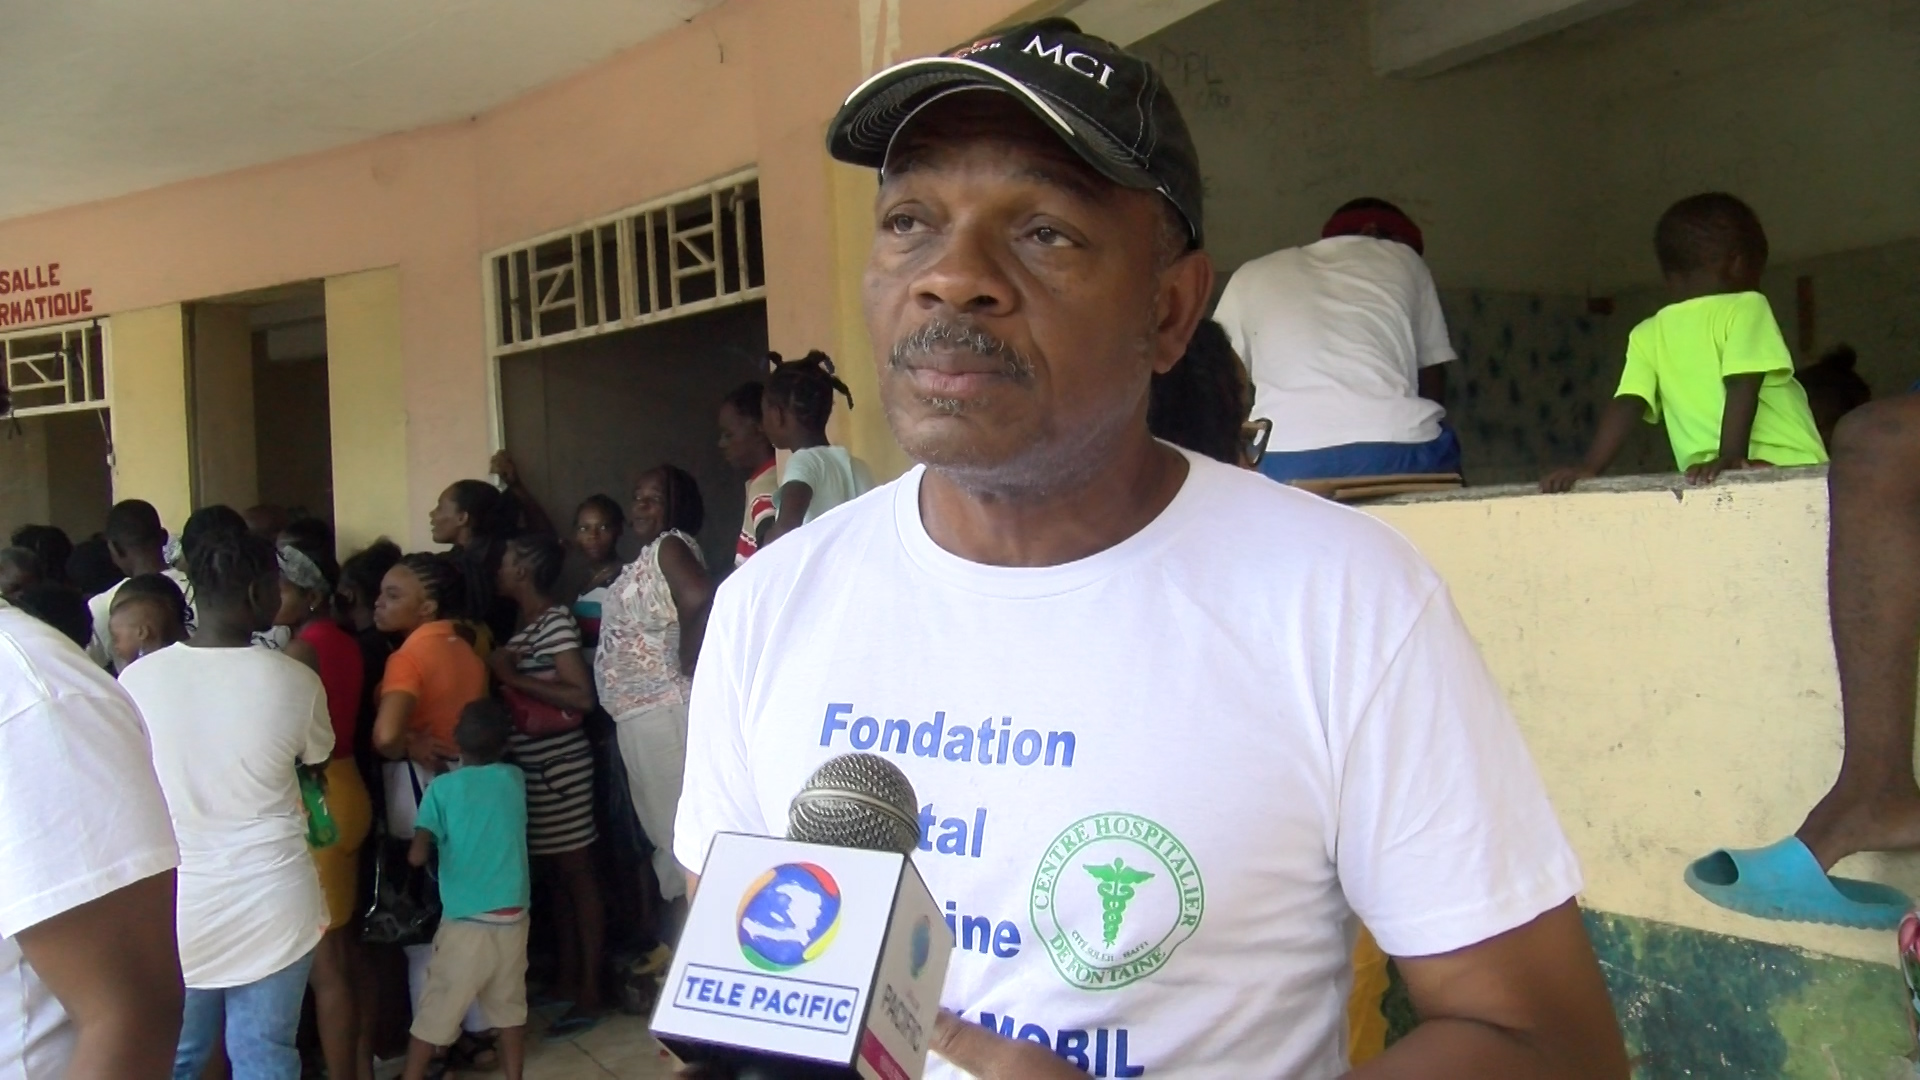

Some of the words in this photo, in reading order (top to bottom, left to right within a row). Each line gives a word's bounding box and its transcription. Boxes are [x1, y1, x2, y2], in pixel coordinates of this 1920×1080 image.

[1020, 34, 1115, 89] MCI
[0, 263, 60, 294] SALLE
[0, 289, 93, 325] RMATIQUE
[819, 702, 1077, 768] Fondation
[1034, 823, 1090, 910] CENTRE
[1094, 816, 1202, 928] HOSPITALIER
[1050, 933, 1072, 964] DE
[1065, 947, 1167, 984] FONTAINE
[686, 976, 745, 1007] TELE
[750, 986, 851, 1024] PACIFIC
